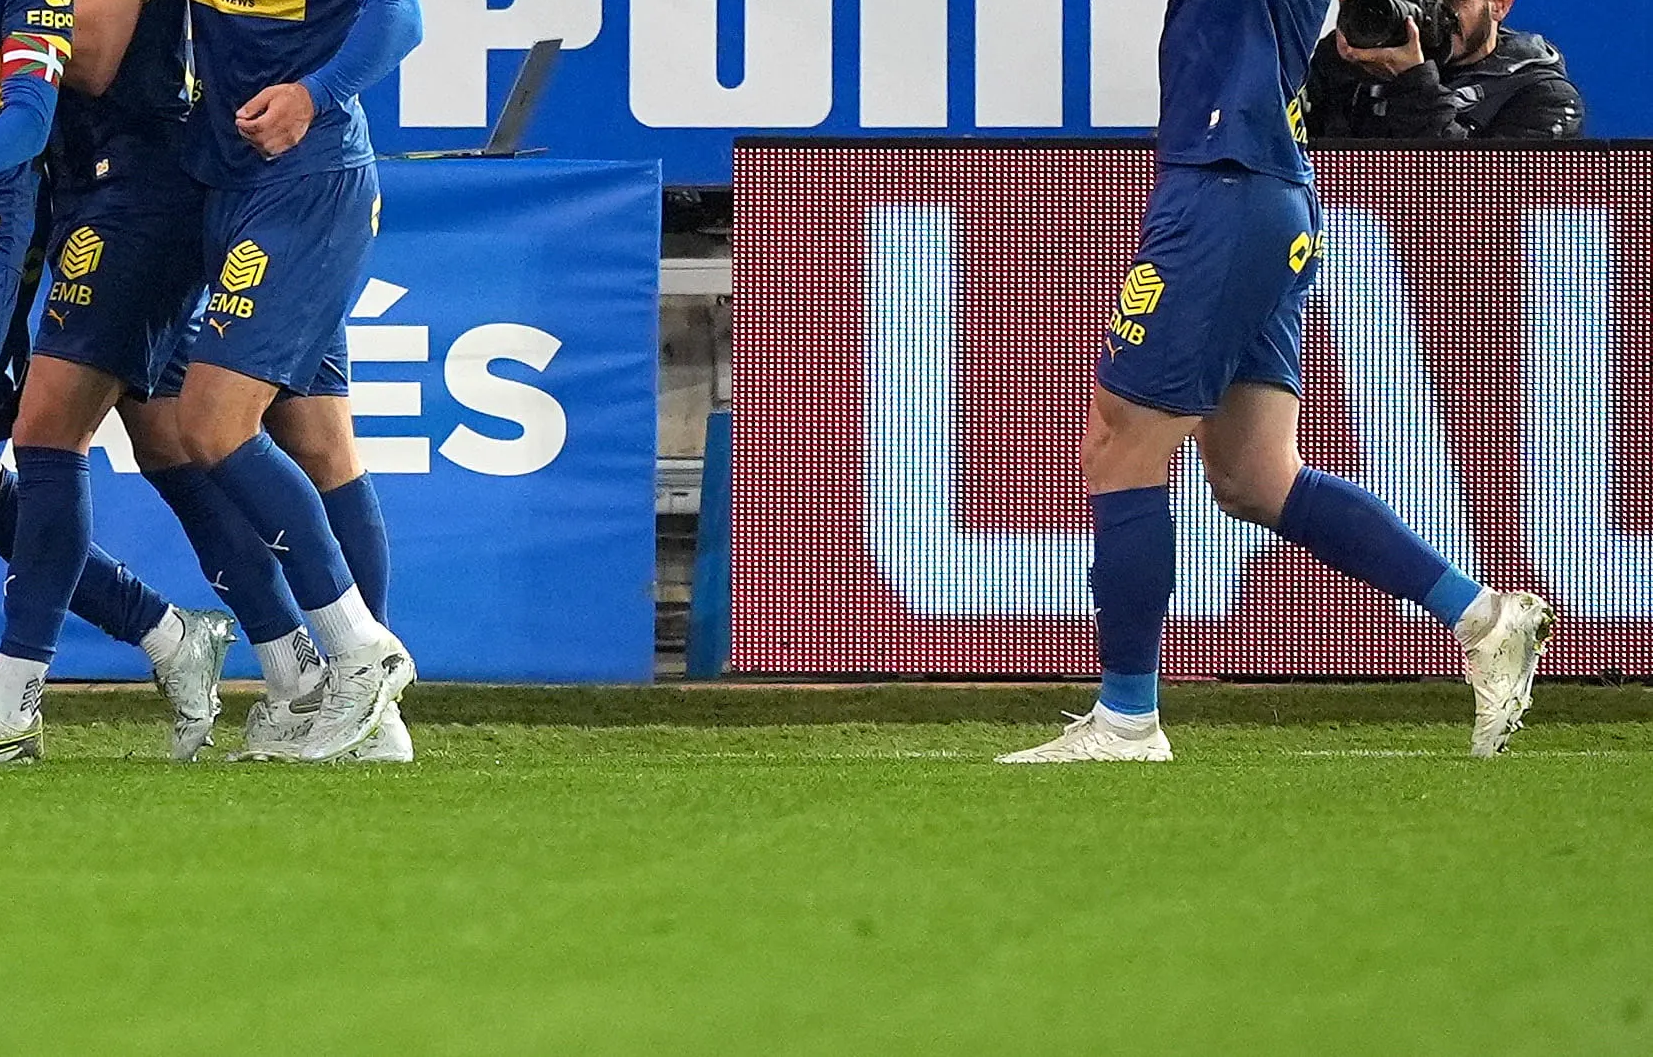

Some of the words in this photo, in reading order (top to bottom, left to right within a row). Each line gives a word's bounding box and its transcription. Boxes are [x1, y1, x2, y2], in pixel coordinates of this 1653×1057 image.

[27, 9, 74, 29] EBpa
[47, 282, 94, 306] EMB
[207, 292, 255, 320] EMB
